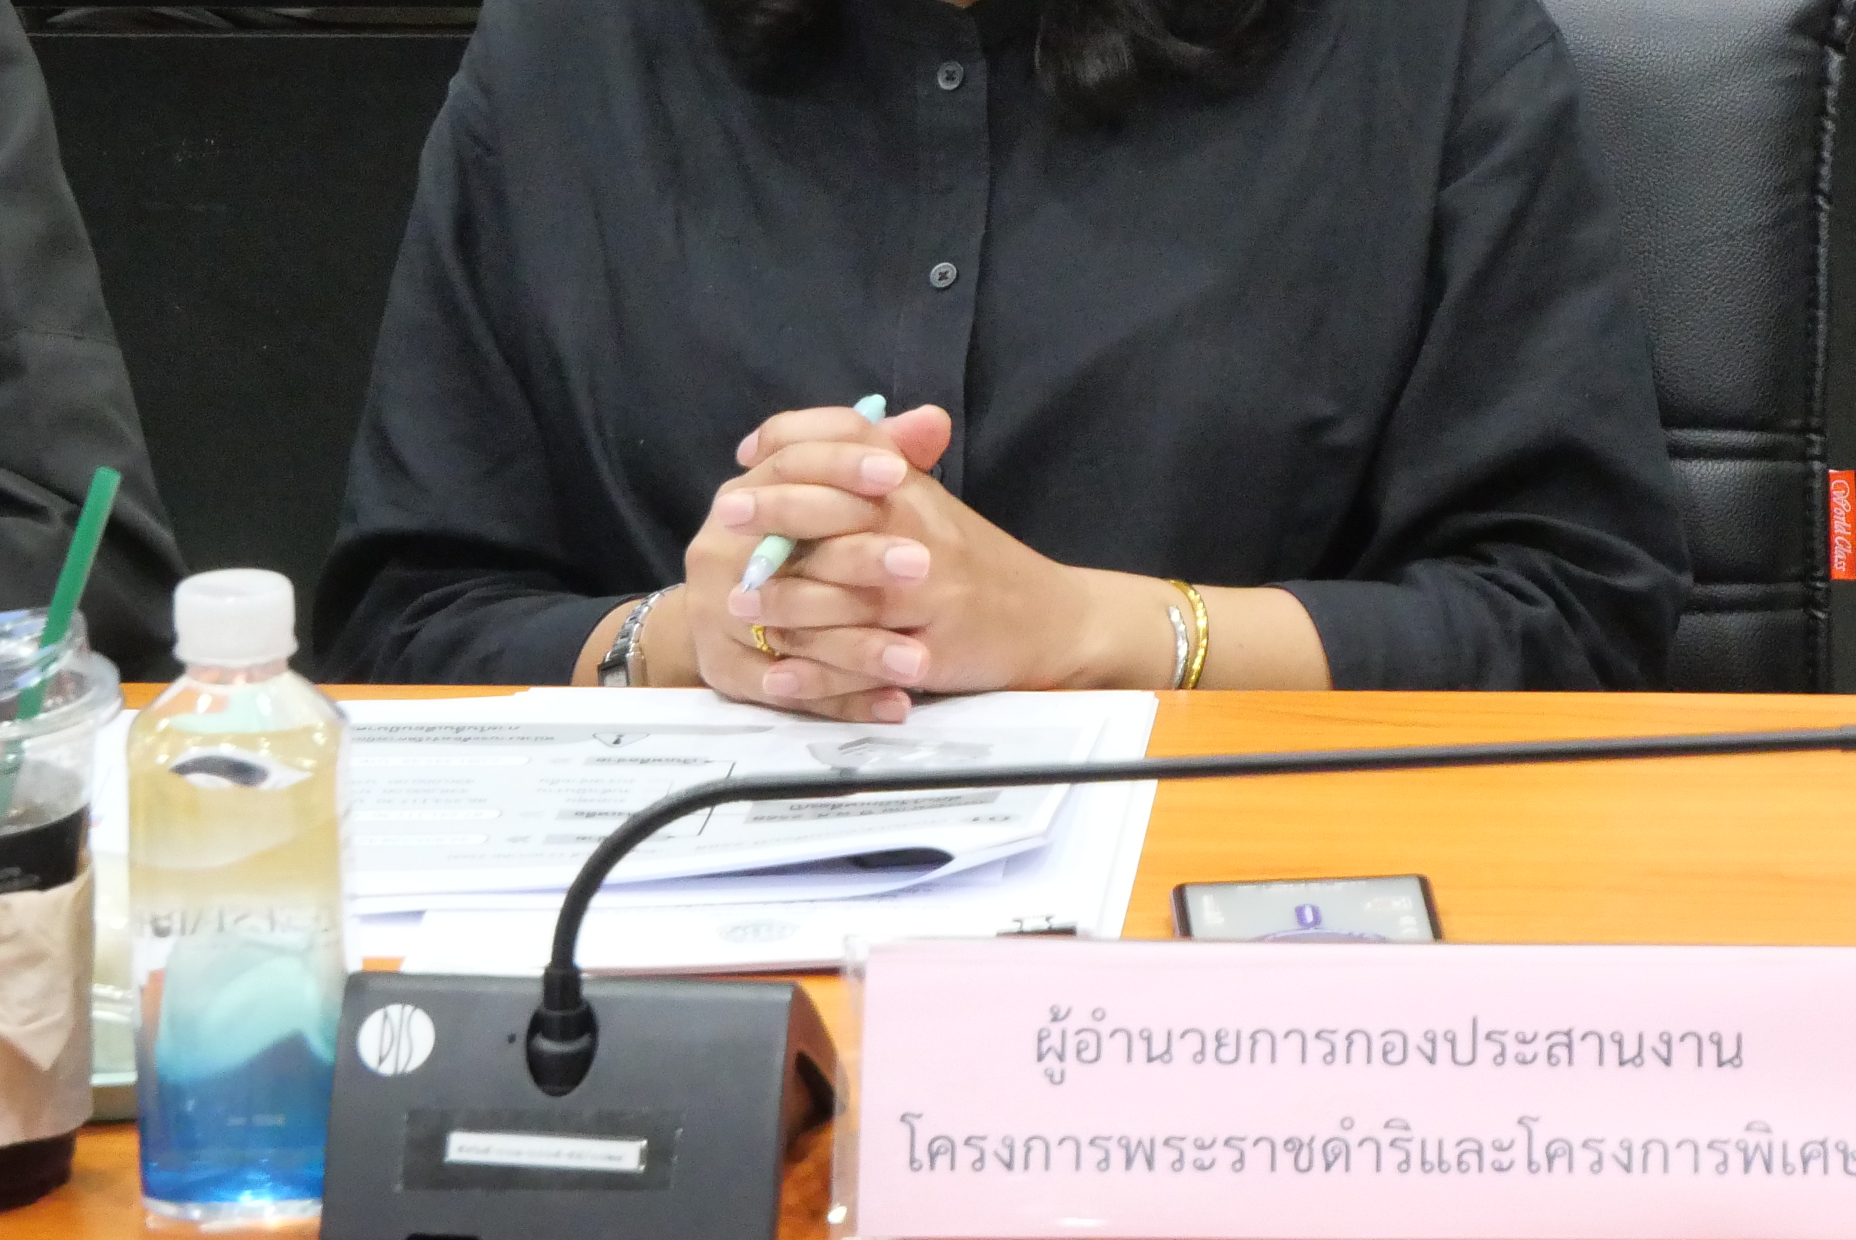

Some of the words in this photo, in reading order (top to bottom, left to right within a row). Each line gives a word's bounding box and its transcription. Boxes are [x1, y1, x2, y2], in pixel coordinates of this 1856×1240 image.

[1831, 479, 1852, 536] World
[1834, 535, 1853, 572] Class
[1035, 1003, 1744, 1087] ผู้อำนวยการกองประสานงาน
